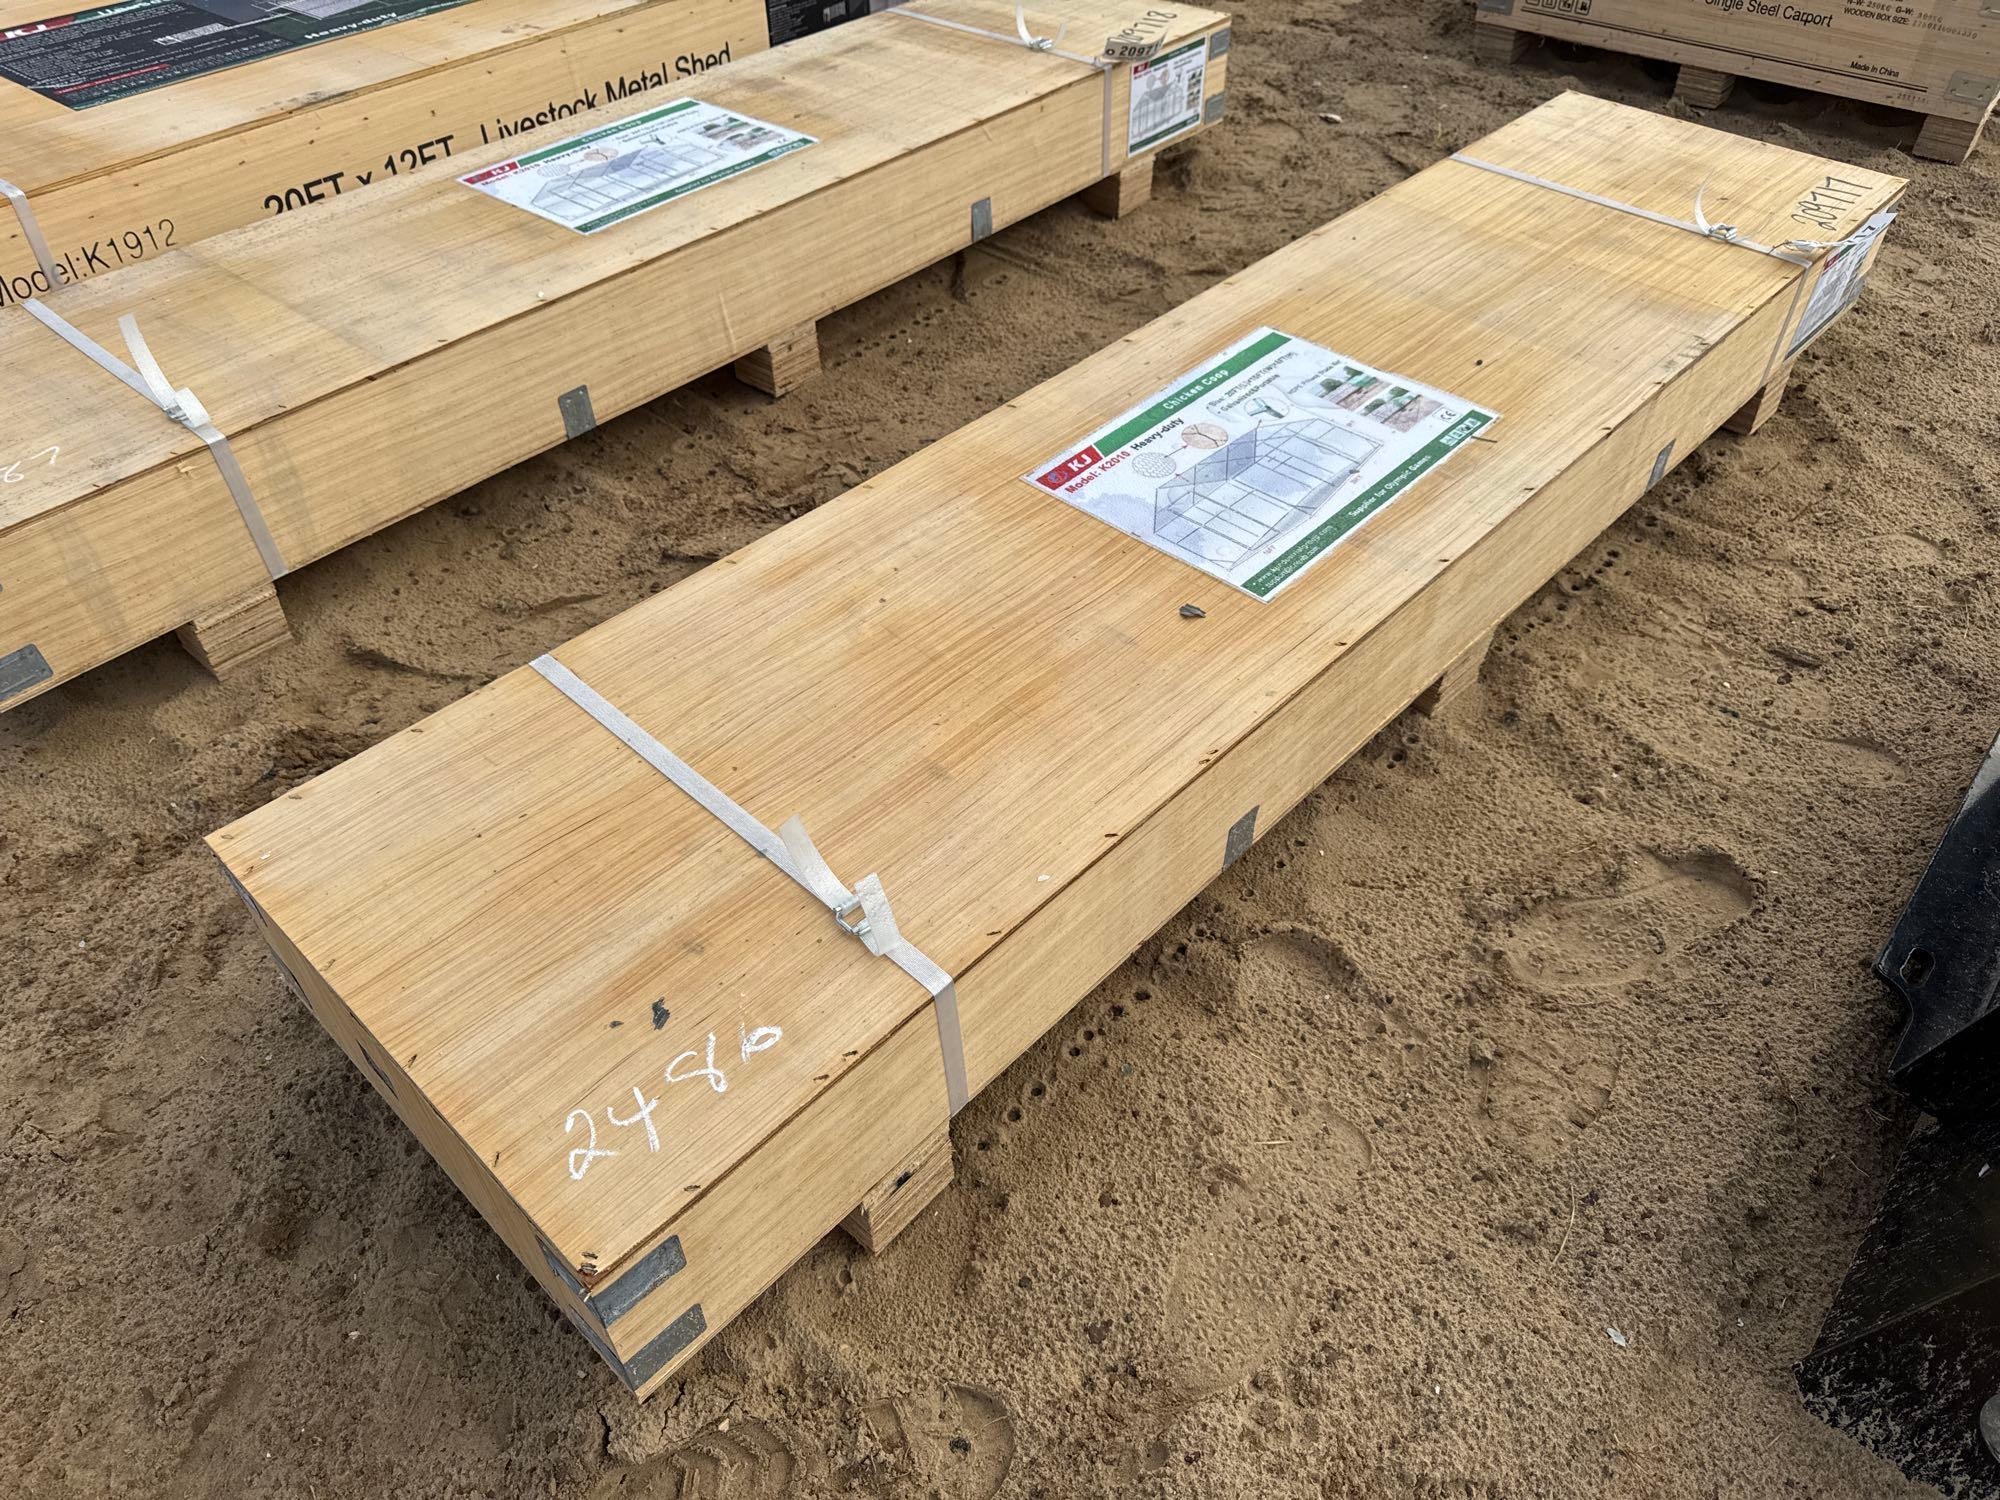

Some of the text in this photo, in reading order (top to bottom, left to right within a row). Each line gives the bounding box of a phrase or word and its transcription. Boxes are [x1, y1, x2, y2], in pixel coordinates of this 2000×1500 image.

[1746, 0, 1782, 17] Steel
[1782, 6, 1833, 27] Carport
[1843, 7, 1876, 19] WOODEN
[1875, 12, 1891, 22] BOX
[1850, 61, 1870, 72] Made
[1878, 66, 1899, 78] China
[480, 89, 598, 146] Livestock
[605, 63, 668, 103] Metal
[674, 41, 732, 80] Shed
[1162, 369, 1229, 410] Chicken Coop
[1065, 417, 1185, 494] Model: K2010 Heavy-duty
[1068, 453, 1093, 472] KJ
[1349, 496, 1377, 517] Supplier
[1384, 469, 1412, 490] Olympic
[1408, 455, 1432, 472] Games
[564, 1020, 783, 1180] 2486
